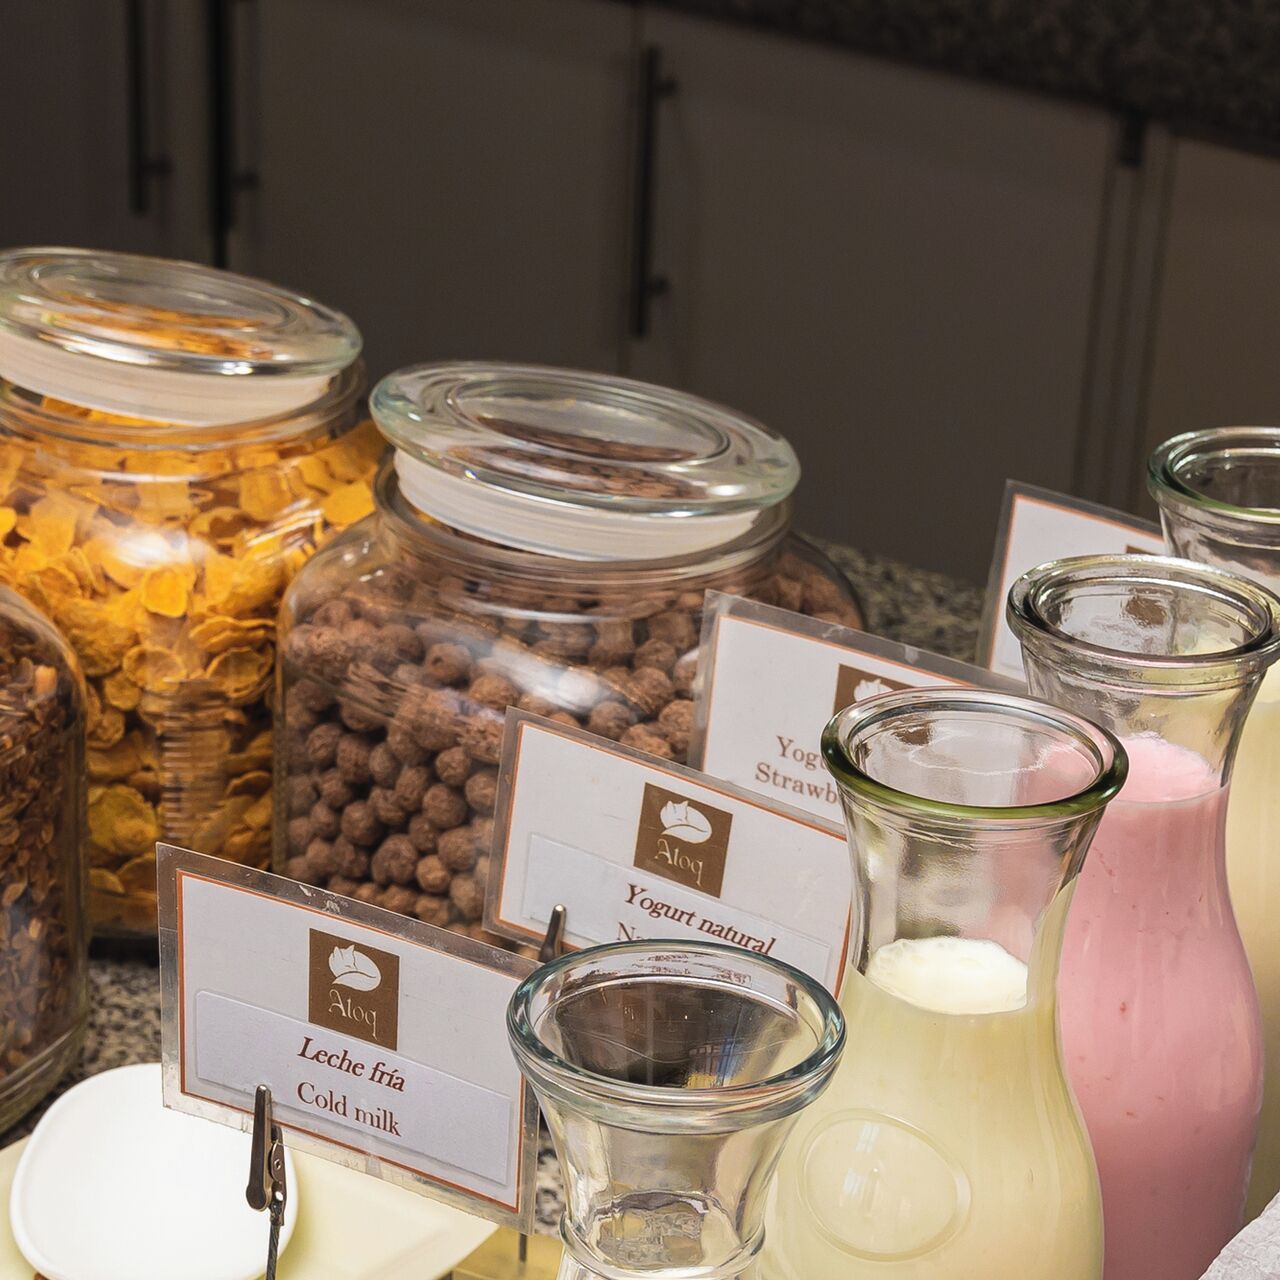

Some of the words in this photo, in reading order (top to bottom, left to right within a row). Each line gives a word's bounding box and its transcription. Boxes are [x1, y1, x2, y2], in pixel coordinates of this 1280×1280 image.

[755, 762, 838, 804] Strawb
[624, 883, 696, 927] Yogurt
[697, 918, 777, 956] natural
[297, 1036, 365, 1077] Leche
[368, 1061, 406, 1092] fría
[297, 1081, 348, 1118] Cold
[354, 1107, 402, 1137] milk
